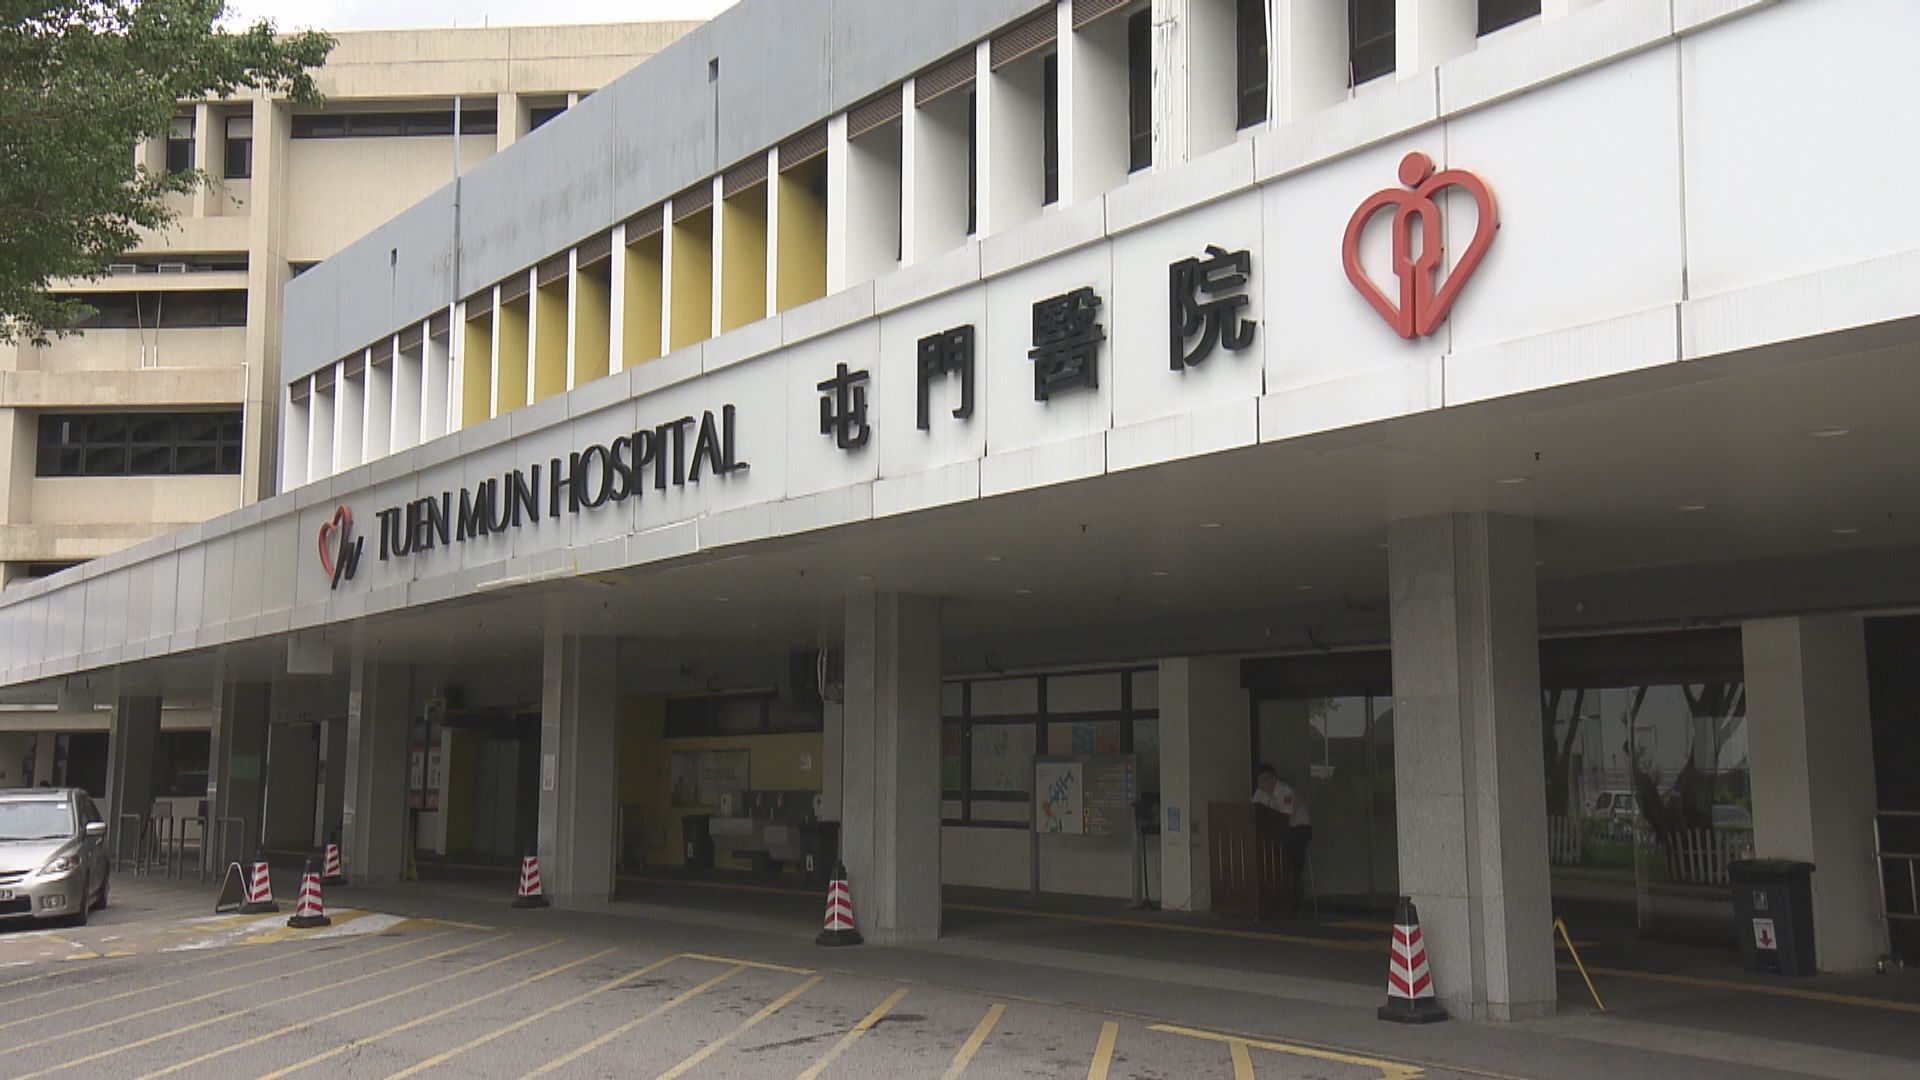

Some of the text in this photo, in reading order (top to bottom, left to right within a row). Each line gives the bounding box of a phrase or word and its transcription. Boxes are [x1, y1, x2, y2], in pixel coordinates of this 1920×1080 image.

[816, 244, 1257, 450] 屯門醫院
[375, 403, 750, 562] TUEN MUN HOSPITAL
